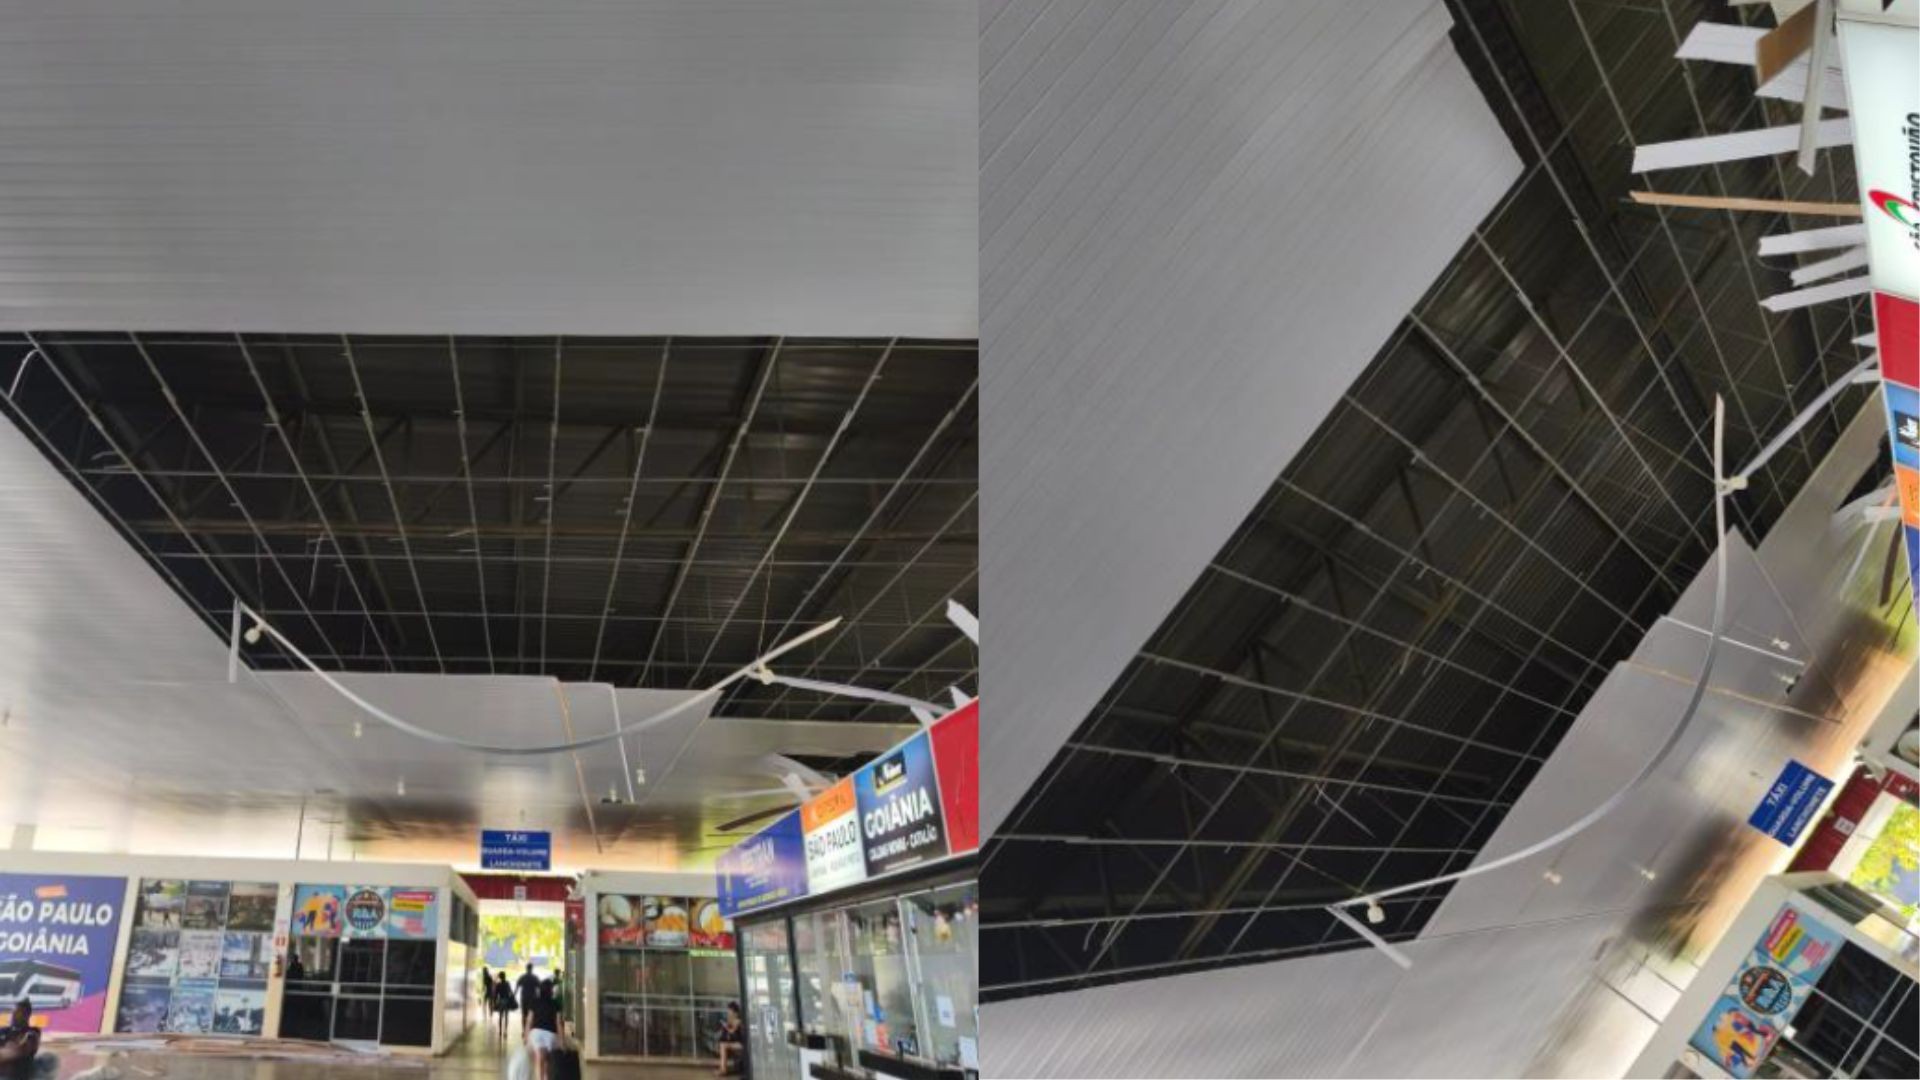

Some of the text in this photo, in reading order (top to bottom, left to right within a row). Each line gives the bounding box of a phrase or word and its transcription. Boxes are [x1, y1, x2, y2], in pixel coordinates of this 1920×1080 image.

[864, 786, 934, 839] GOIÂNIA
[808, 833, 826, 861] SÃO
[826, 820, 857, 852] PAULO
[38, 902, 114, 926] PAULO
